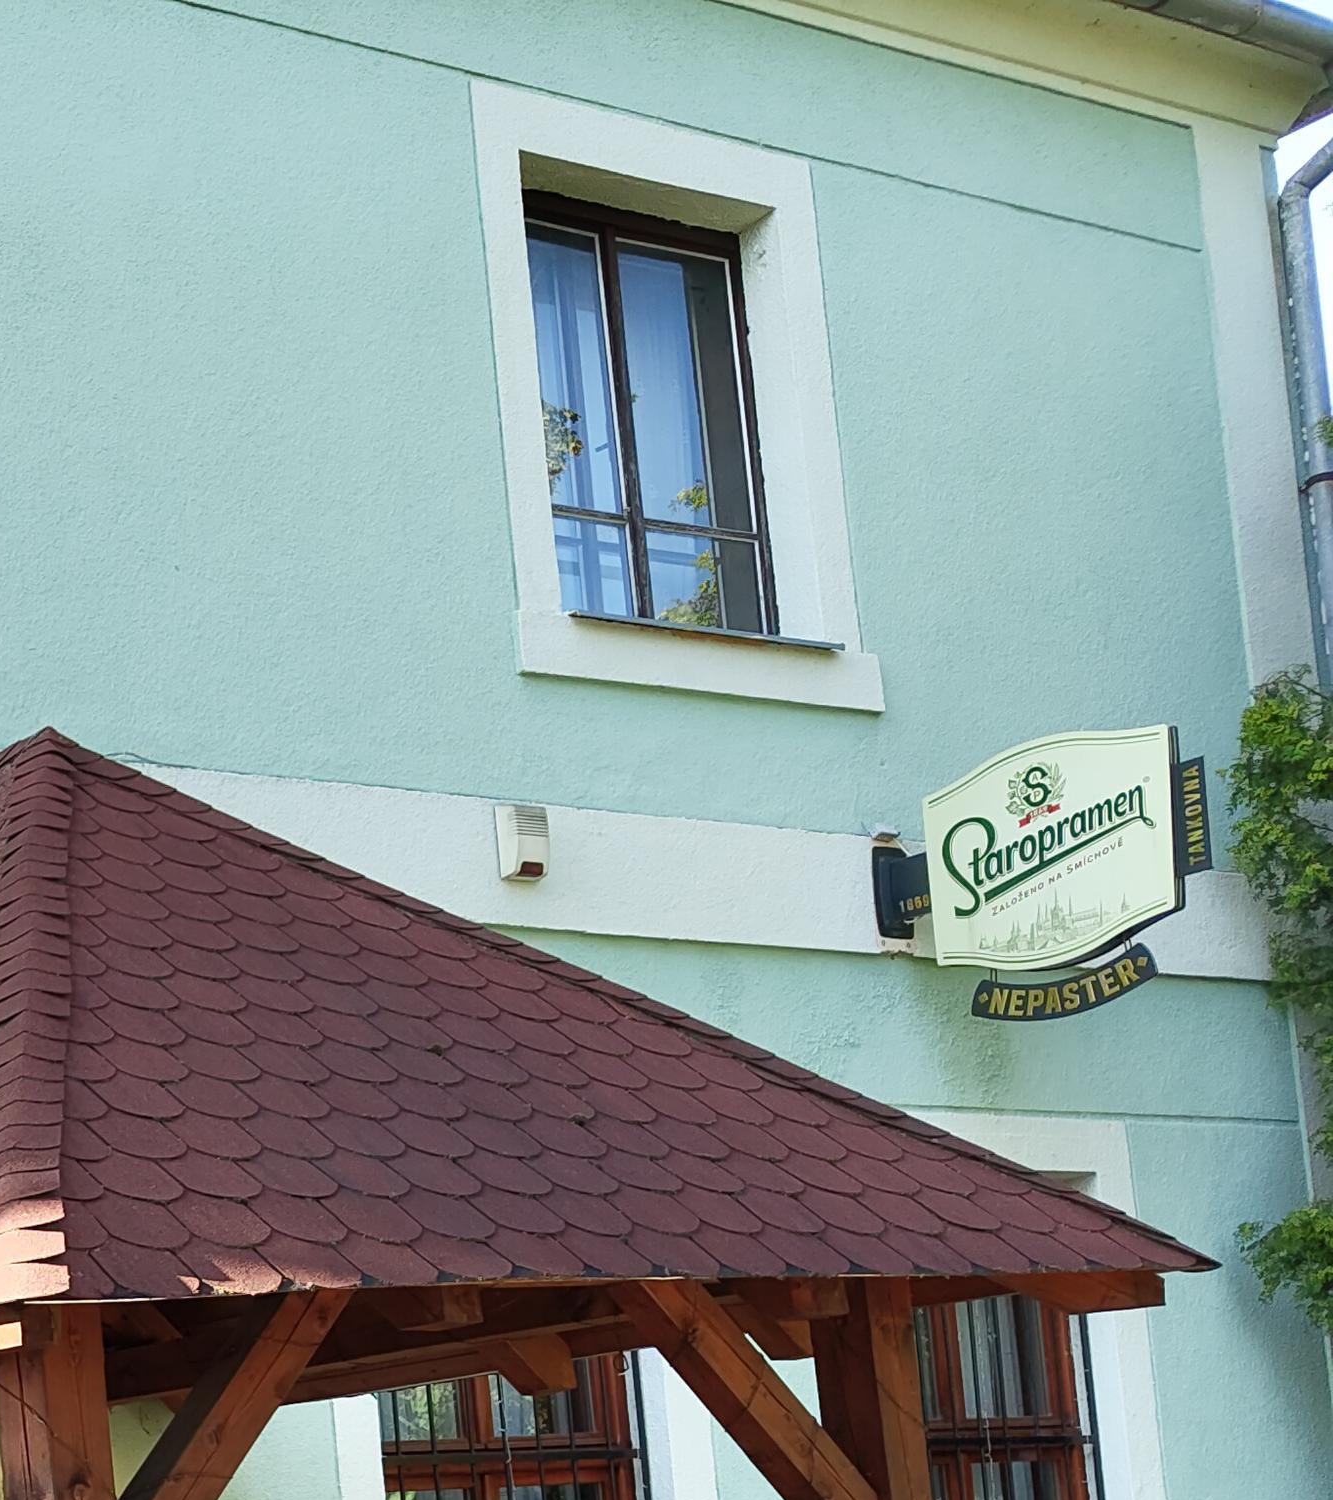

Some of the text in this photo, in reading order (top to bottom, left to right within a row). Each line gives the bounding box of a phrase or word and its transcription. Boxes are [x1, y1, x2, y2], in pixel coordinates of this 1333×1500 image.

[942, 783, 1156, 917] Staropramen
[1181, 764, 1207, 866] TANKOVNA
[991, 881, 1044, 917] ZALOŽENO
[1048, 872, 1063, 885] NA
[988, 958, 1140, 1016] NEPASTER
